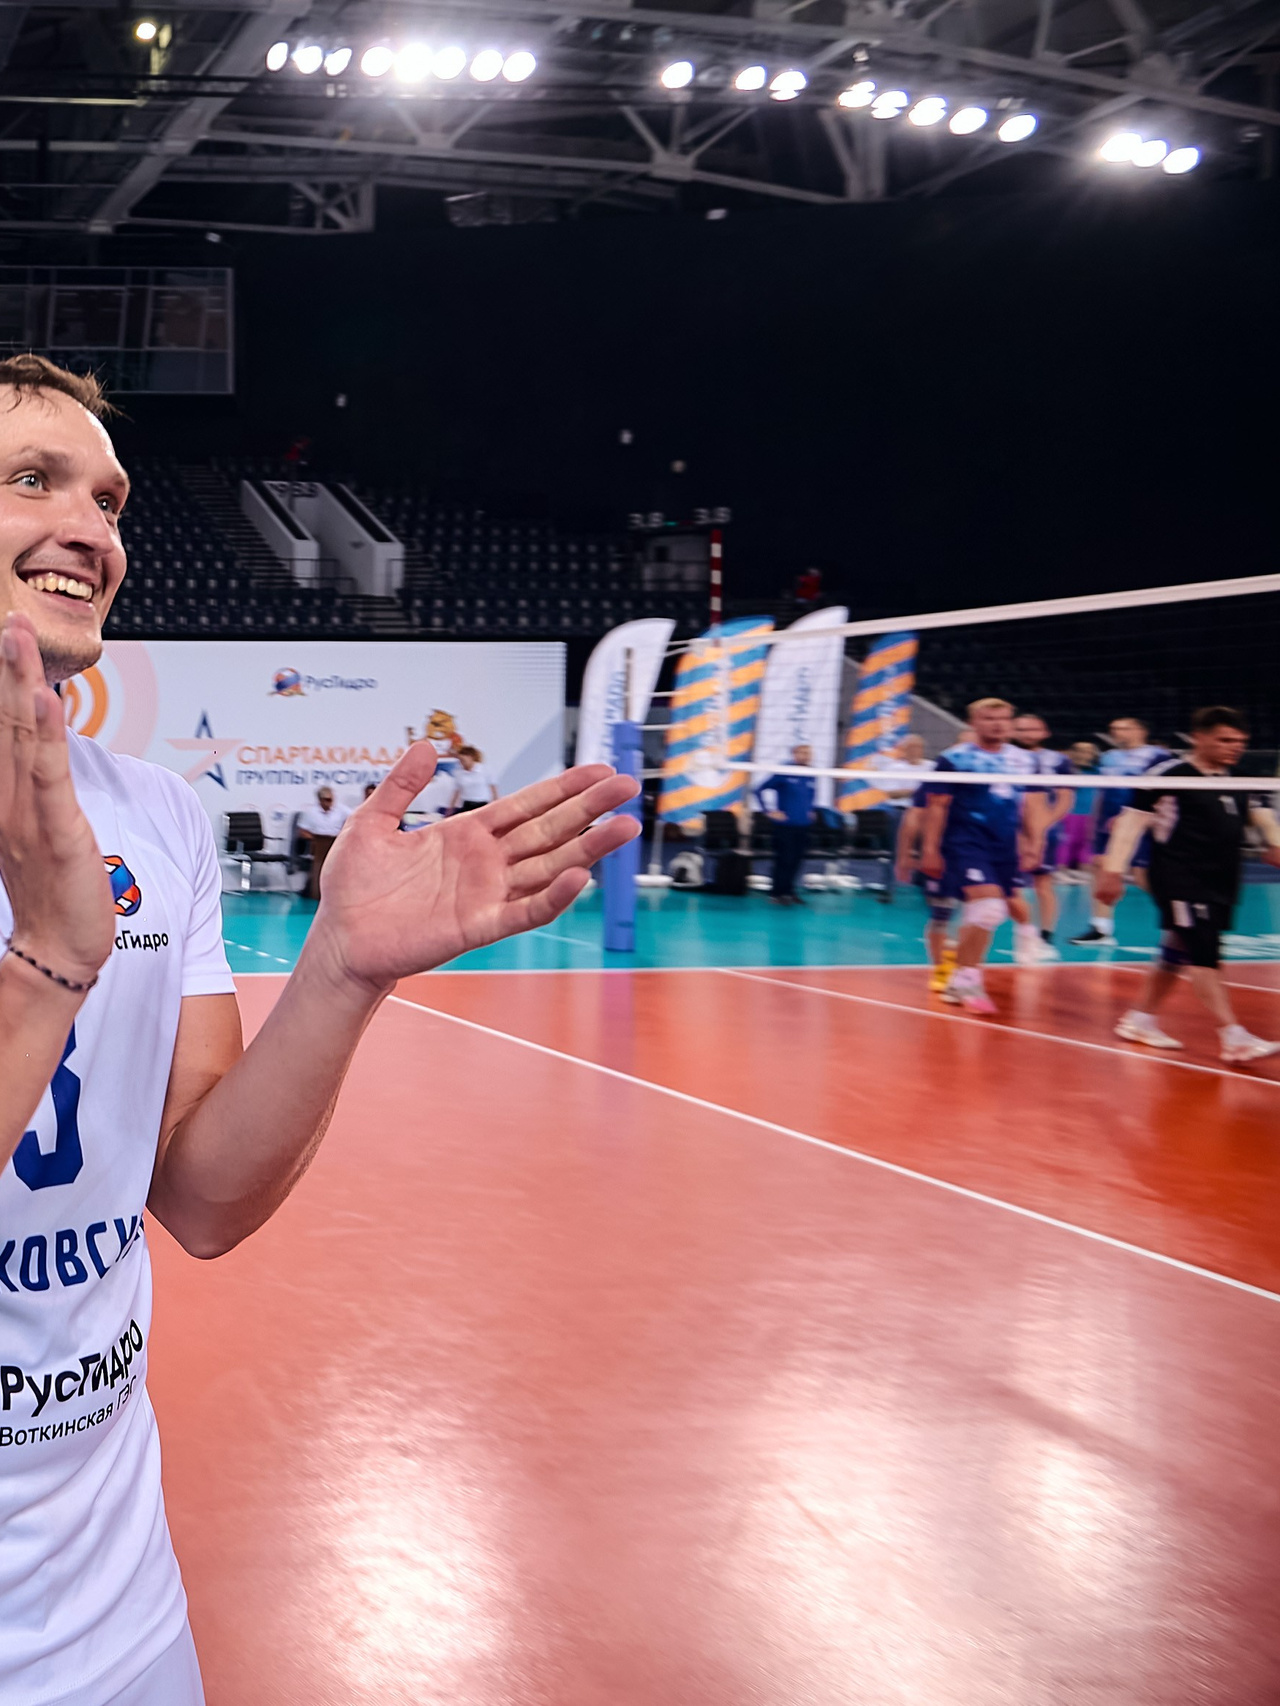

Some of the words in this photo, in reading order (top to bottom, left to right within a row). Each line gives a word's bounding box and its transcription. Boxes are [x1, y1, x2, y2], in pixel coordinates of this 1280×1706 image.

[236, 769, 308, 785] ГРУППЫ
[311, 769, 390, 785] РУСГИД
[114, 930, 169, 952] сГидро
[0, 1318, 144, 1418] РусГидро
